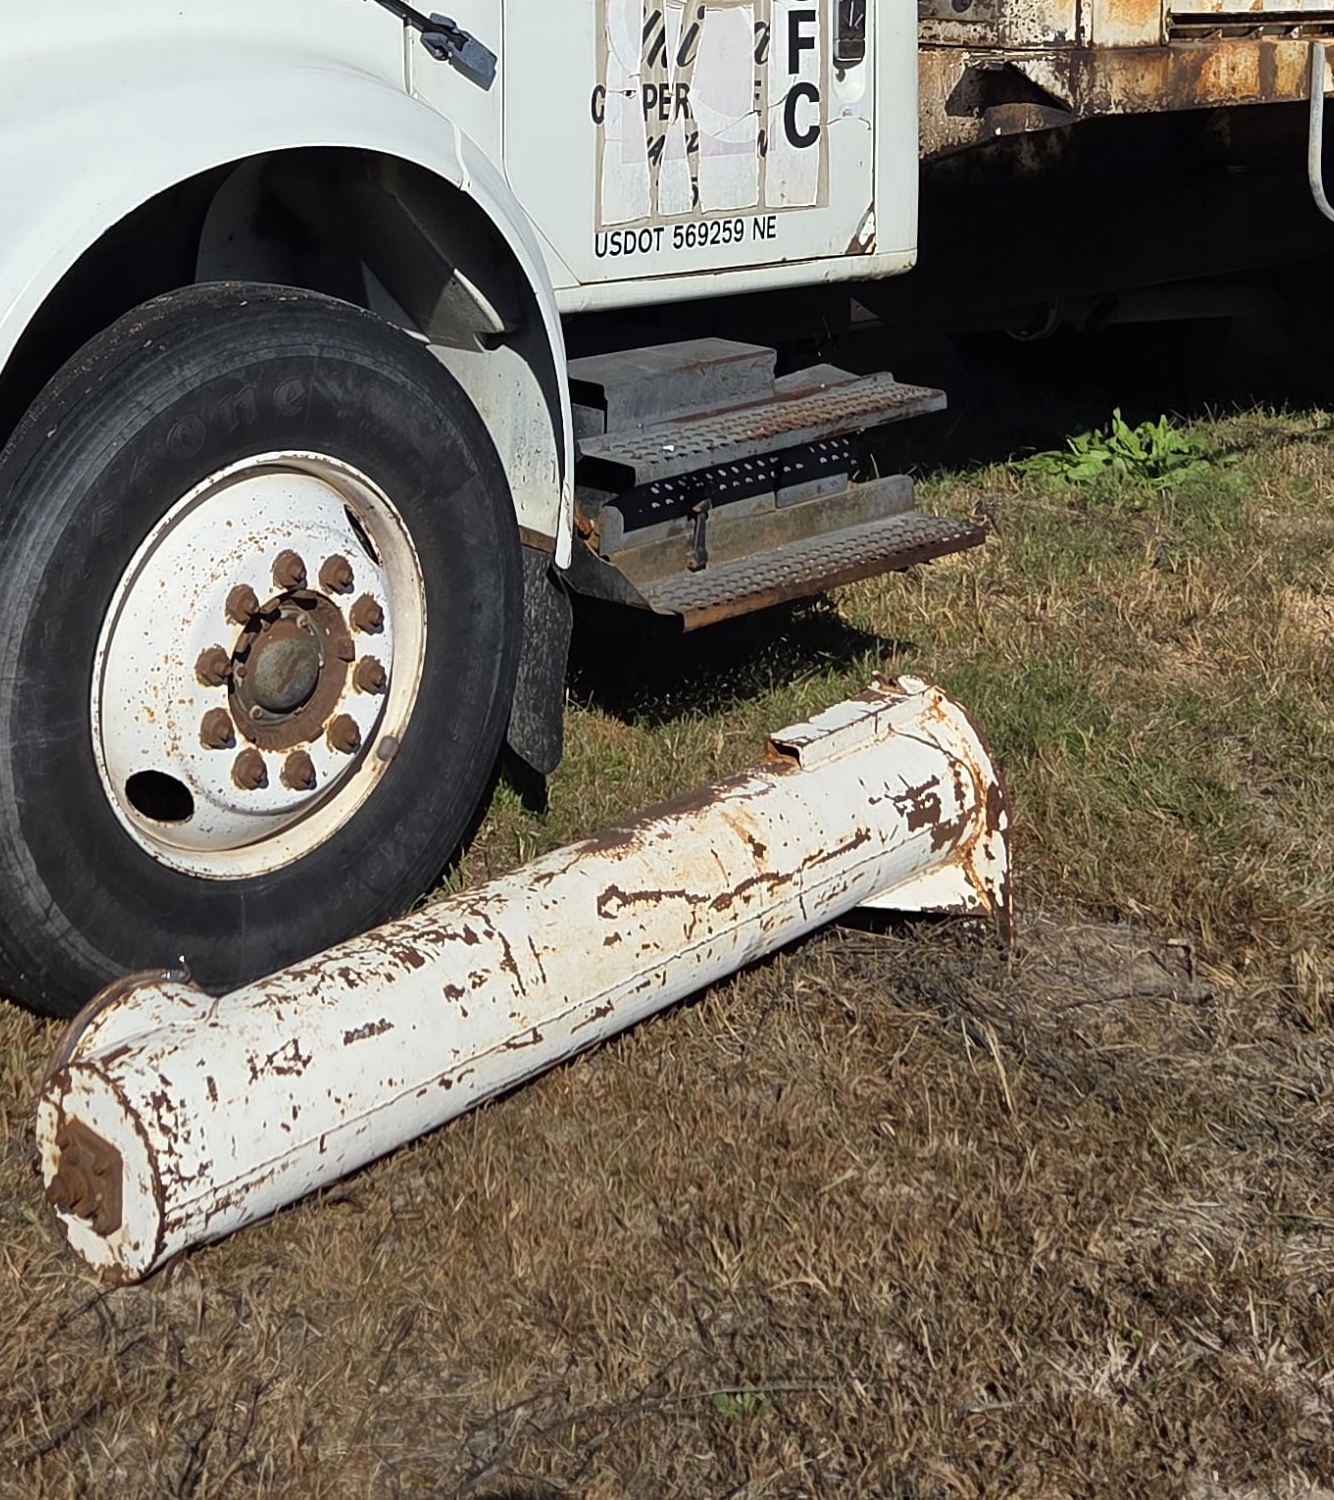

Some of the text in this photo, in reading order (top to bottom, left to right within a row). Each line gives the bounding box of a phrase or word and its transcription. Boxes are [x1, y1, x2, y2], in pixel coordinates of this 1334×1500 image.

[594, 215, 777, 258] USDOT 569259 NE
